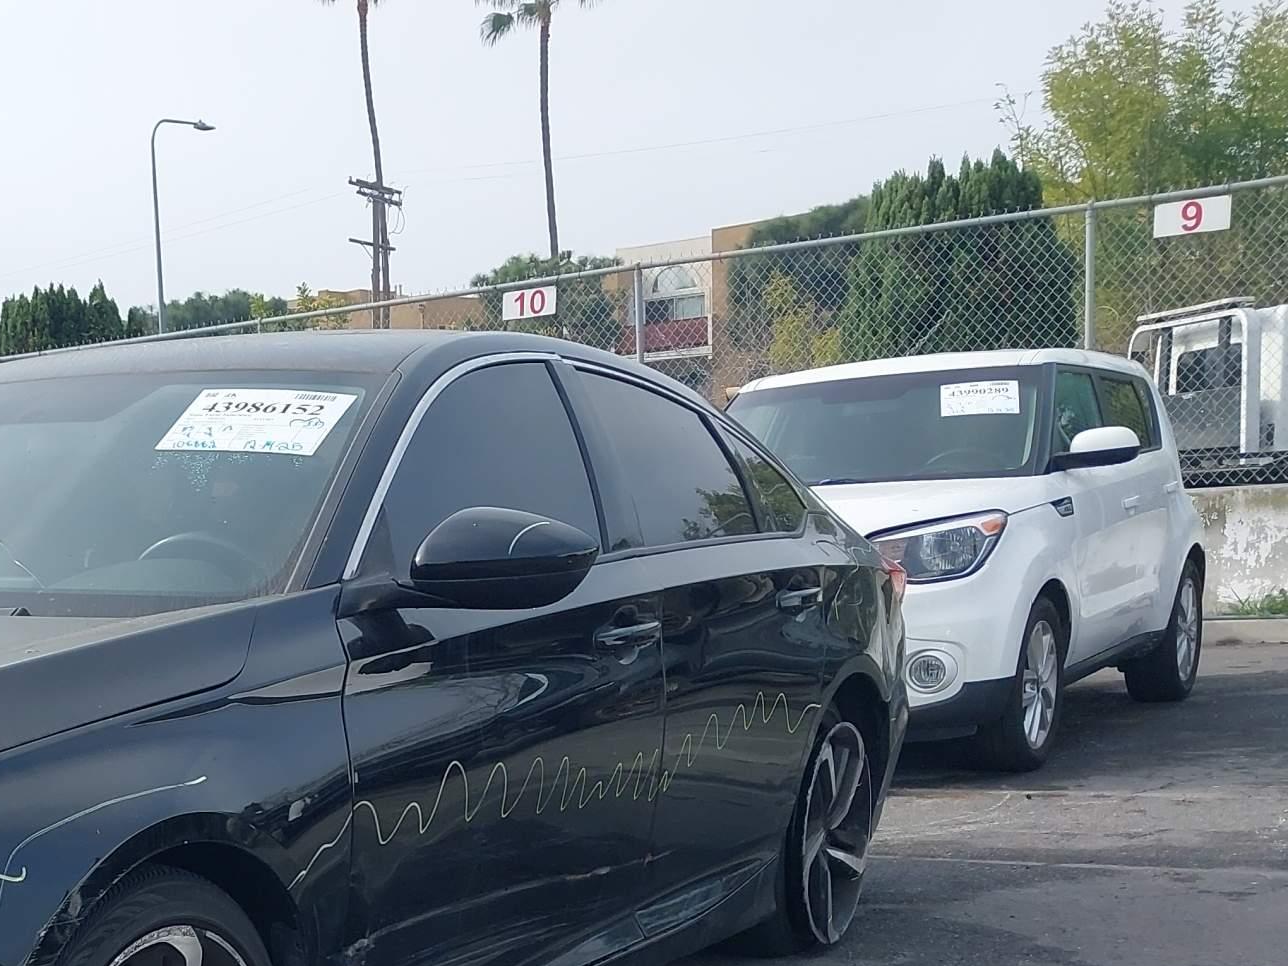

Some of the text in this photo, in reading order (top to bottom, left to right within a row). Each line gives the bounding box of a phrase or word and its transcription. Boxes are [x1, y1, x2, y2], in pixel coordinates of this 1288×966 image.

[1181, 200, 1203, 232] 9
[514, 289, 546, 317] 10
[202, 401, 325, 416] 43986152
